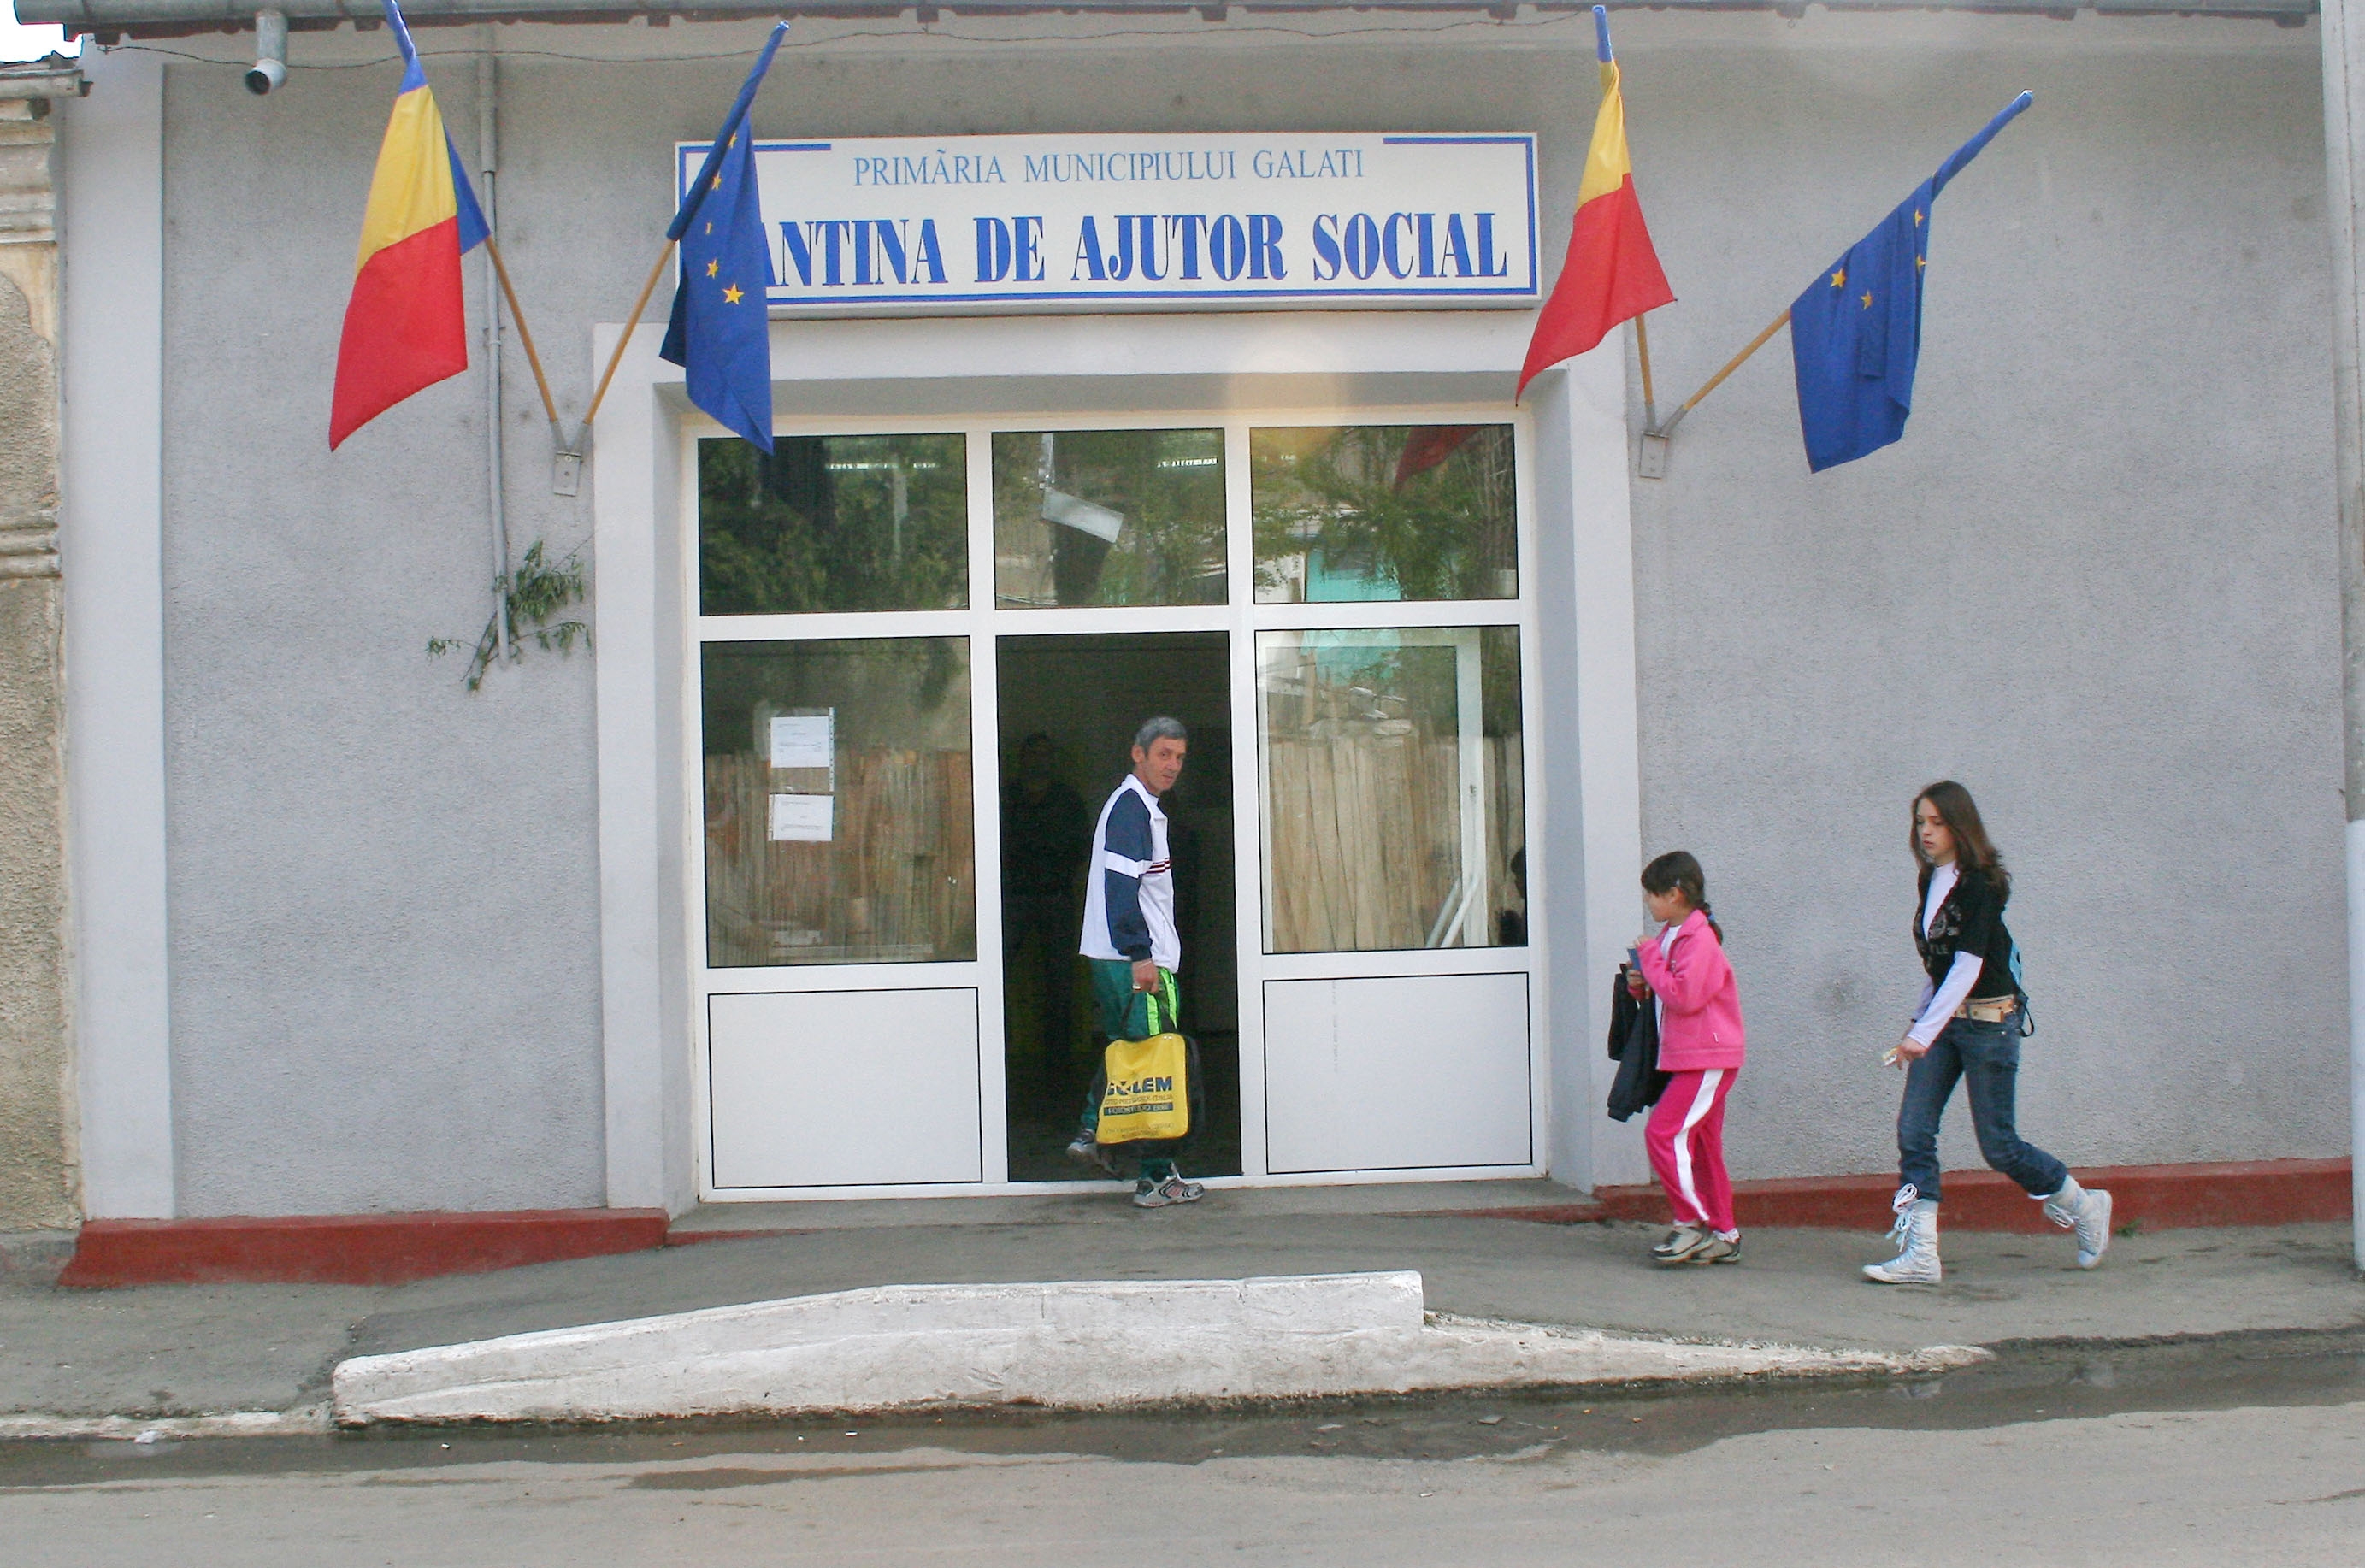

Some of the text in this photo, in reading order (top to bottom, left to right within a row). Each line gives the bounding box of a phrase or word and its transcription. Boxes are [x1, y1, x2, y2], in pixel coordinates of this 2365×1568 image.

[1025, 150, 1236, 182] MUNICIPIULUI
[1253, 149, 1363, 178] GALATI
[973, 215, 1045, 283] DE
[1070, 214, 1288, 281] AJUTOR
[1312, 212, 1507, 281] SOCIAL
